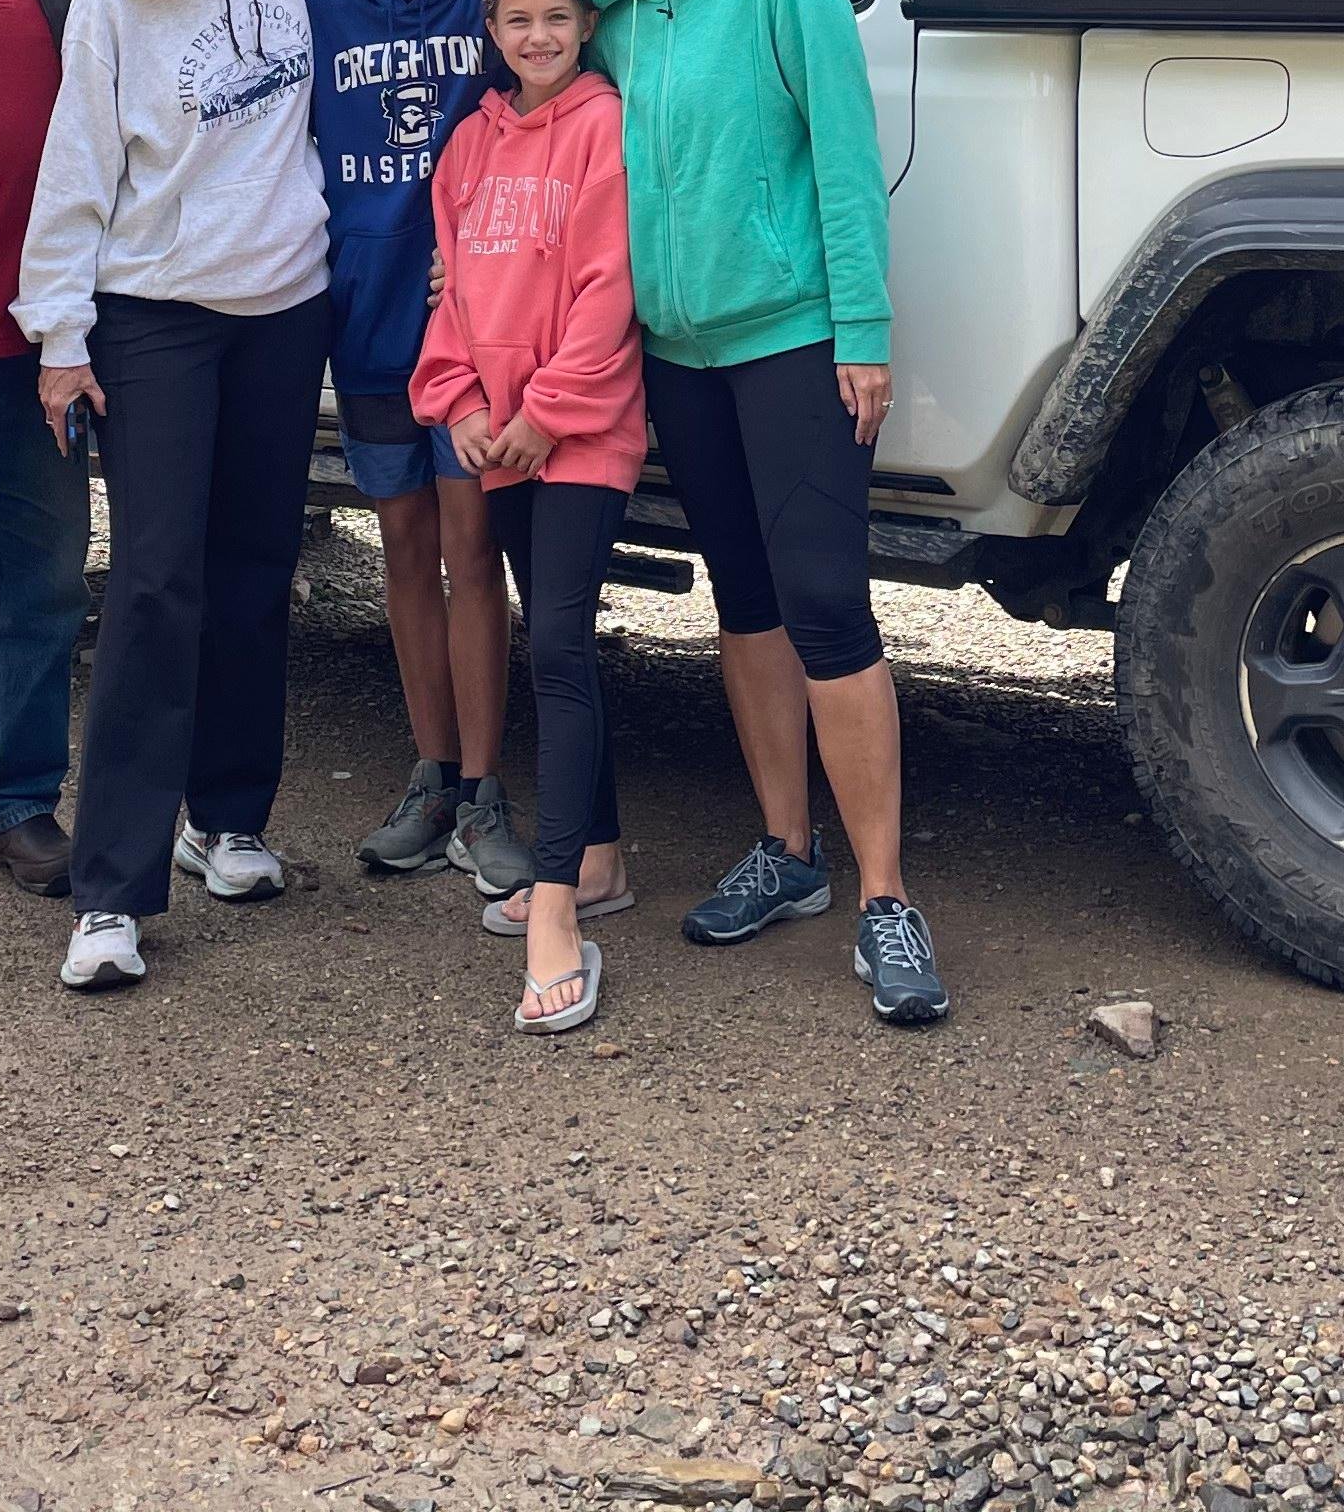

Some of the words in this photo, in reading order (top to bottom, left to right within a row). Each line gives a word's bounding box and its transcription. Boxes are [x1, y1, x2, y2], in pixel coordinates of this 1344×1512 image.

[178, 55, 198, 115] PIKES
[191, 12, 231, 52] PEAK
[333, 36, 484, 93] CREIGHTON
[228, 107, 253, 122] LIFE
[341, 152, 434, 183] BASEB
